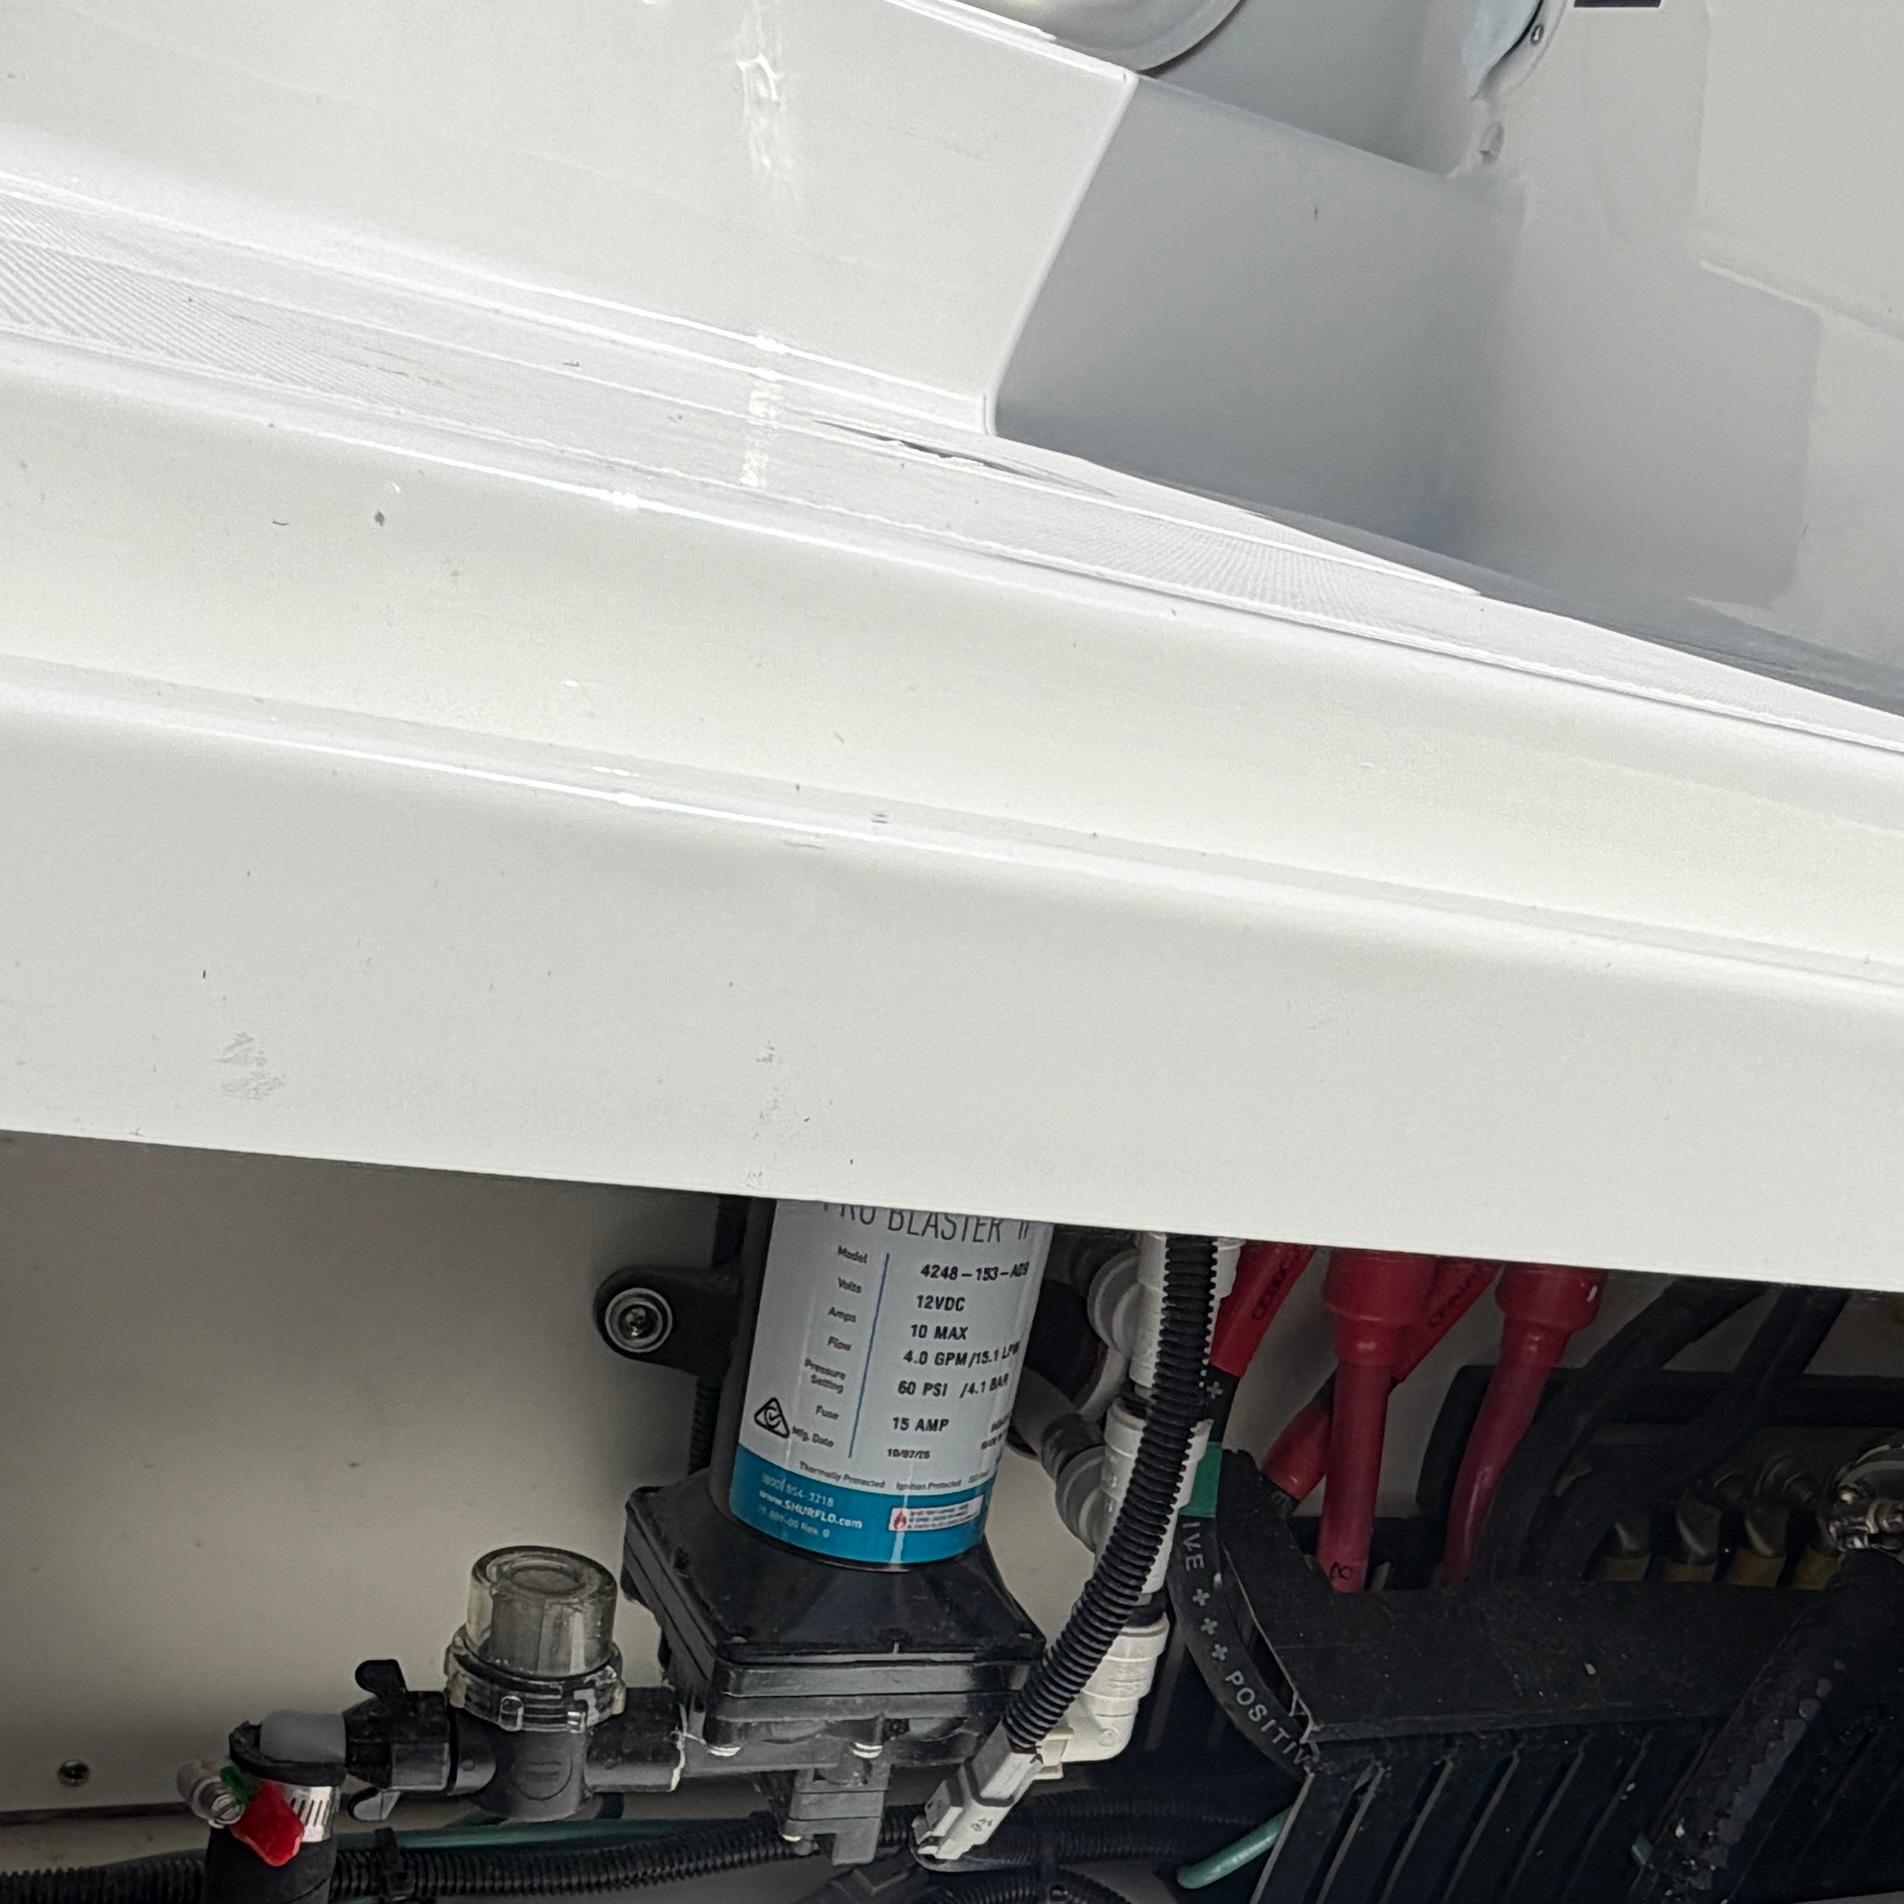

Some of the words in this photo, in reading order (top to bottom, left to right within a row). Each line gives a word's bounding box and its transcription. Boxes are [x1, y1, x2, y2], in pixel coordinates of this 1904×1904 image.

[887, 1209, 1002, 1243] BLASTER
[836, 1245, 868, 1265] Model
[837, 1276, 863, 1295] Volts
[915, 1294, 966, 1312] 12VDC
[827, 1306, 857, 1324] Amps
[910, 1324, 928, 1340] 10
[933, 1325, 969, 1341] MAX
[827, 1335, 852, 1352] Flow
[903, 1349, 929, 1366] 4.0
[804, 1358, 846, 1380] Pressure
[810, 1373, 844, 1394] Setting
[897, 1380, 917, 1396] 60
[922, 1381, 948, 1398] PSI
[959, 1380, 987, 1398] /4.1
[989, 1373, 1010, 1391] BAR
[815, 1404, 840, 1421] Fuse
[892, 1416, 910, 1432] 15
[914, 1417, 949, 1432] AMP
[812, 1430, 835, 1448] Date
[798, 1460, 842, 1482] Thermally
[843, 1473, 886, 1490] Protected
[1223, 1668, 1311, 1764] POSITIV
